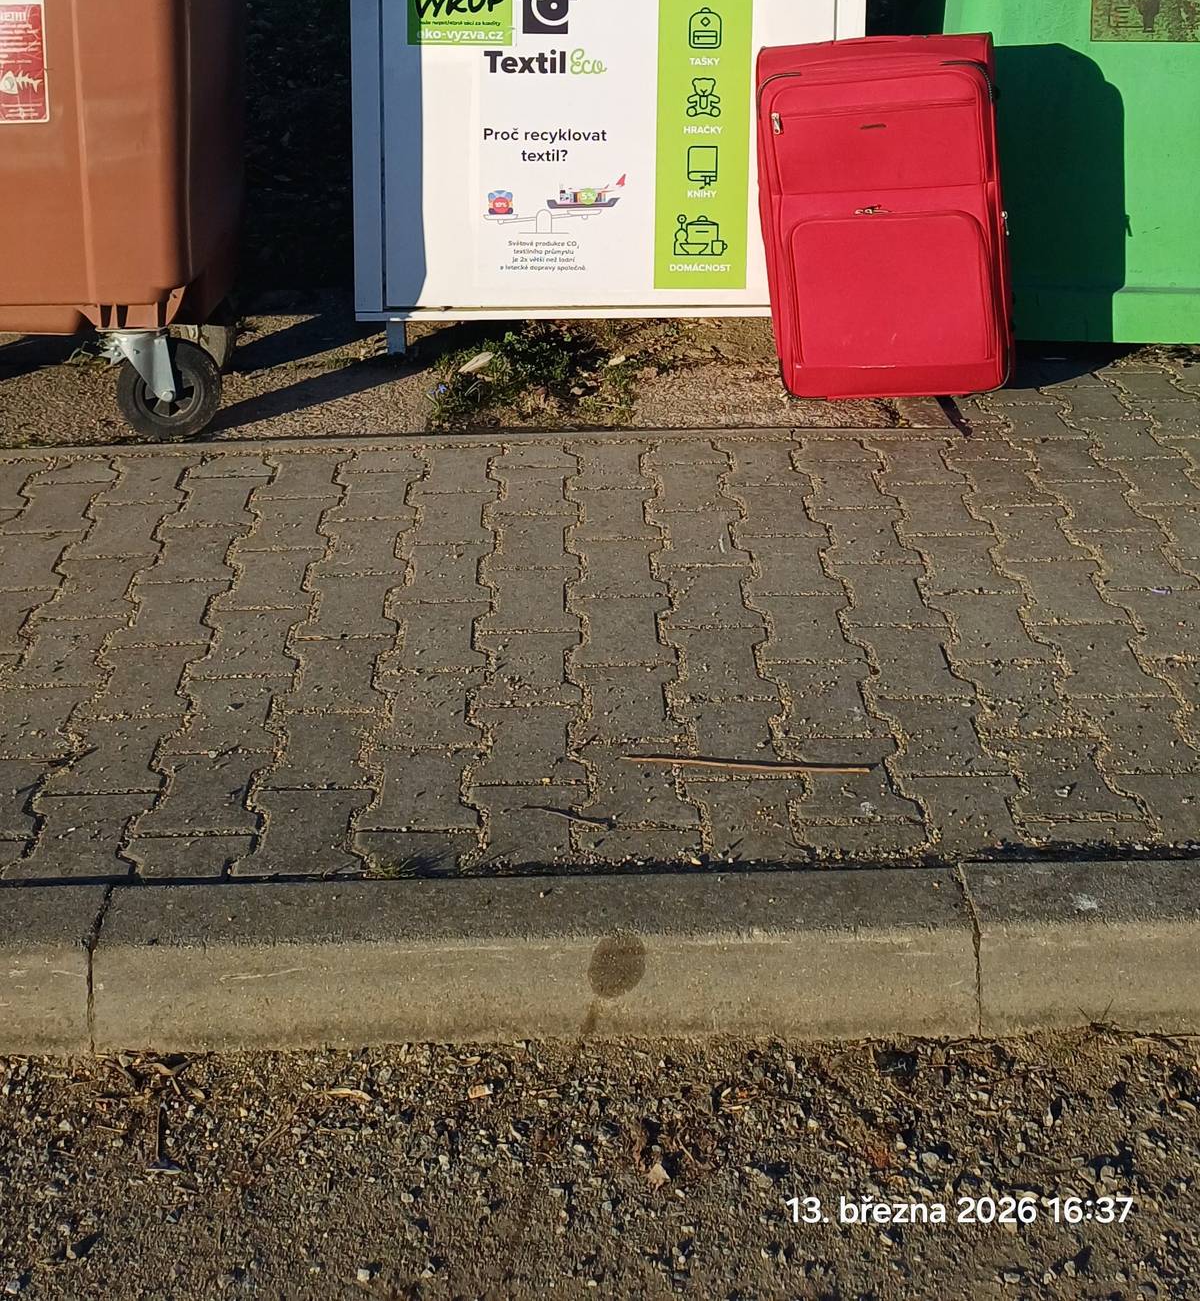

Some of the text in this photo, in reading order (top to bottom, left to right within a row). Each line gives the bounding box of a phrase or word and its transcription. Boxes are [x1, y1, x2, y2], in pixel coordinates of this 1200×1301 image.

[416, 28, 504, 42] eko-vyzva.cz
[483, 48, 608, 75] Textil Eco
[689, 55, 720, 66] TAŠKY
[483, 127, 608, 144] Proč recyklovat
[683, 125, 722, 135] HRAČKY
[521, 149, 569, 162] textil?
[582, 192, 595, 200] 5%
[669, 261, 732, 273] DOMÁCNOST
